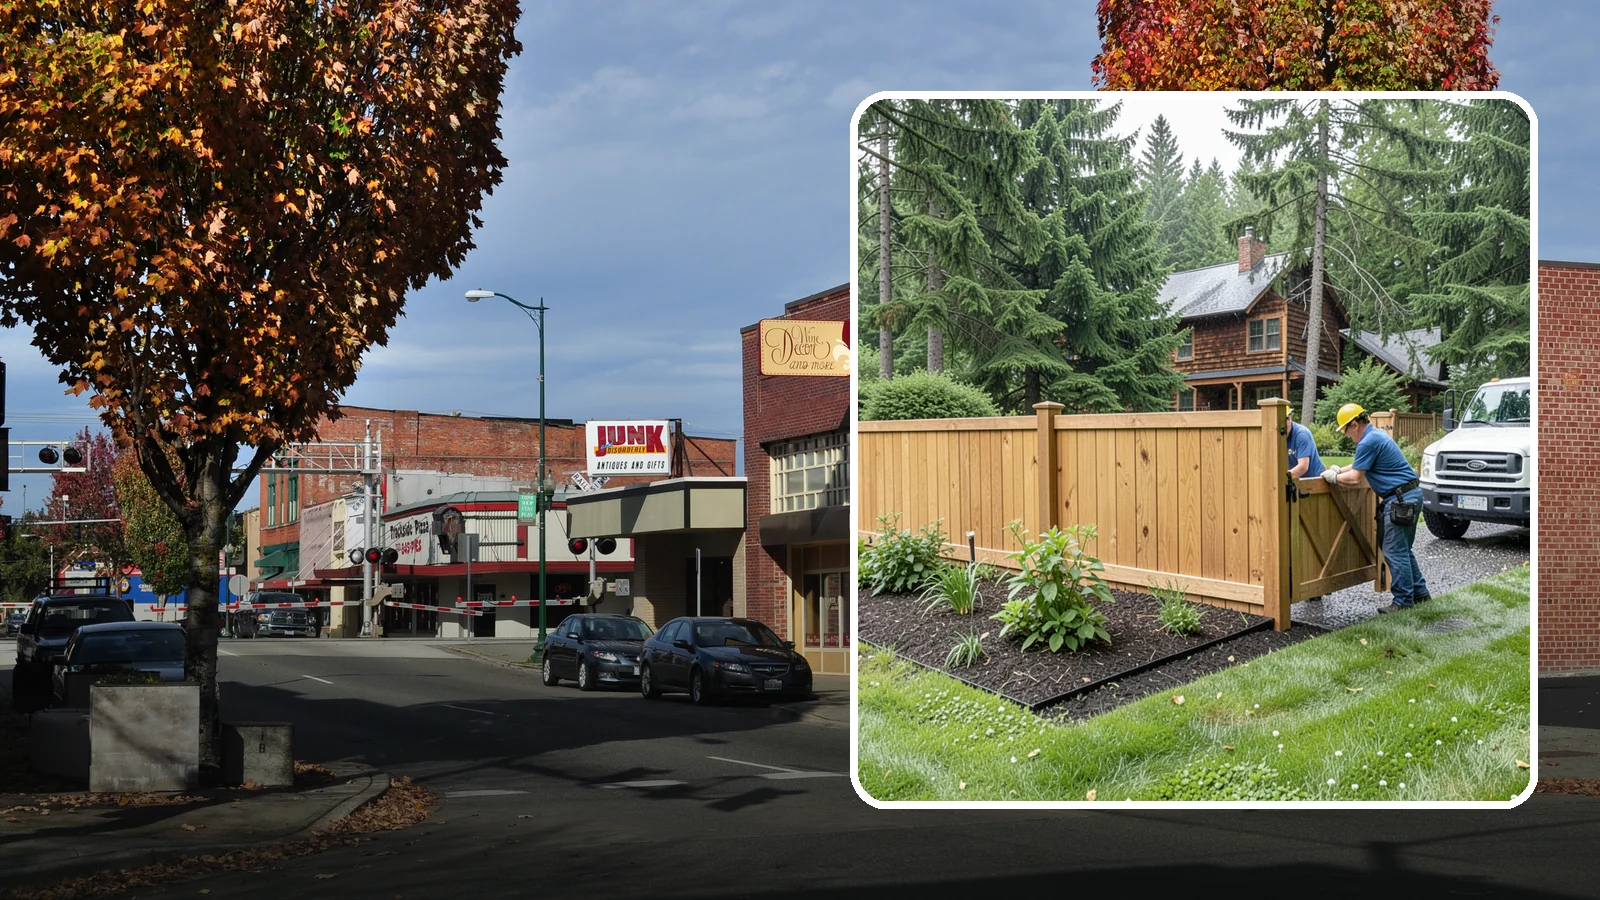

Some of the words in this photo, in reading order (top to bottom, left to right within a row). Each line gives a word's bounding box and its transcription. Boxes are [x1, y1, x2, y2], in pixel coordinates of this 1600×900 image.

[595, 425, 665, 457] JUNK
[607, 446, 645, 454] DISORDERLY
[597, 461, 628, 470] ANTIQUES
[631, 461, 644, 470] AND
[647, 460, 665, 470] GIFTS
[390, 522, 413, 540] Trackside
[415, 519, 429, 534] Pizza
